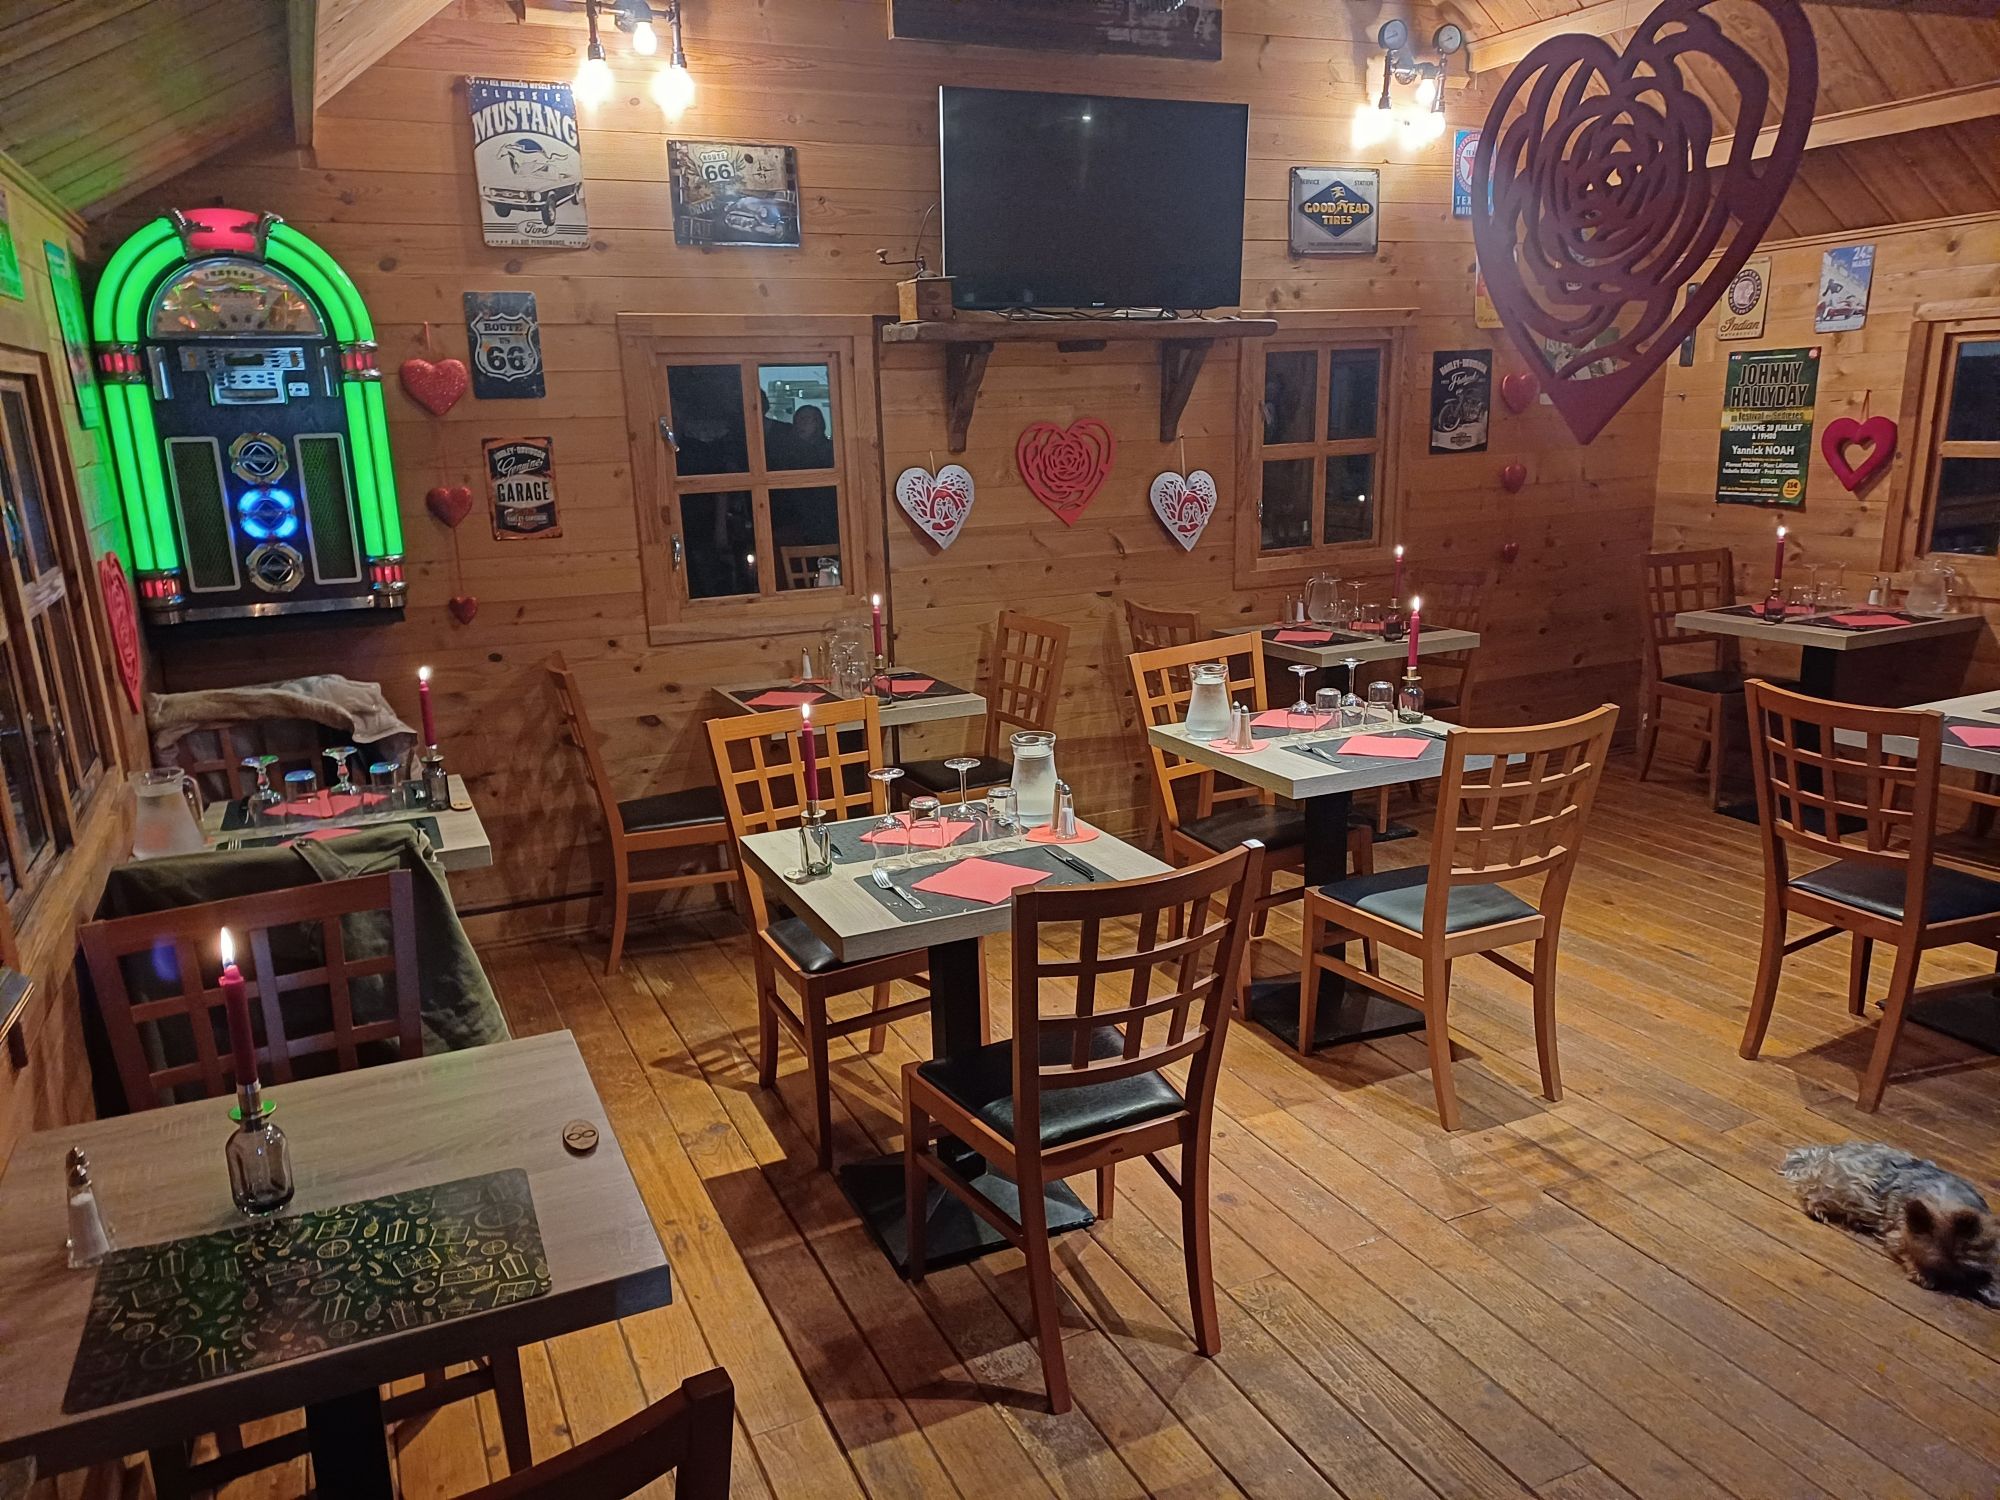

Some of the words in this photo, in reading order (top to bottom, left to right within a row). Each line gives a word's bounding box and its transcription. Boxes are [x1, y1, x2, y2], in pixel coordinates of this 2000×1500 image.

[481, 88, 561, 101] CLASSIC
[472, 101, 578, 147] MUSTANG
[702, 151, 726, 161] ROUTE
[705, 163, 731, 181] 66
[1322, 215, 1352, 225] TIRES
[525, 222, 549, 234] Ford
[483, 323, 523, 332] ROUTE
[1720, 317, 1760, 333] Indian
[486, 346, 526, 371] 66
[1738, 361, 1804, 386] JOHNNY
[1730, 384, 1809, 407] HALLYDAY
[1729, 424, 1766, 432] DIMANCHE
[1774, 424, 1803, 432] JUILLET
[1731, 445, 1763, 455] Yannick
[1765, 445, 1795, 455] NOAH
[497, 482, 550, 502] GARAGE
